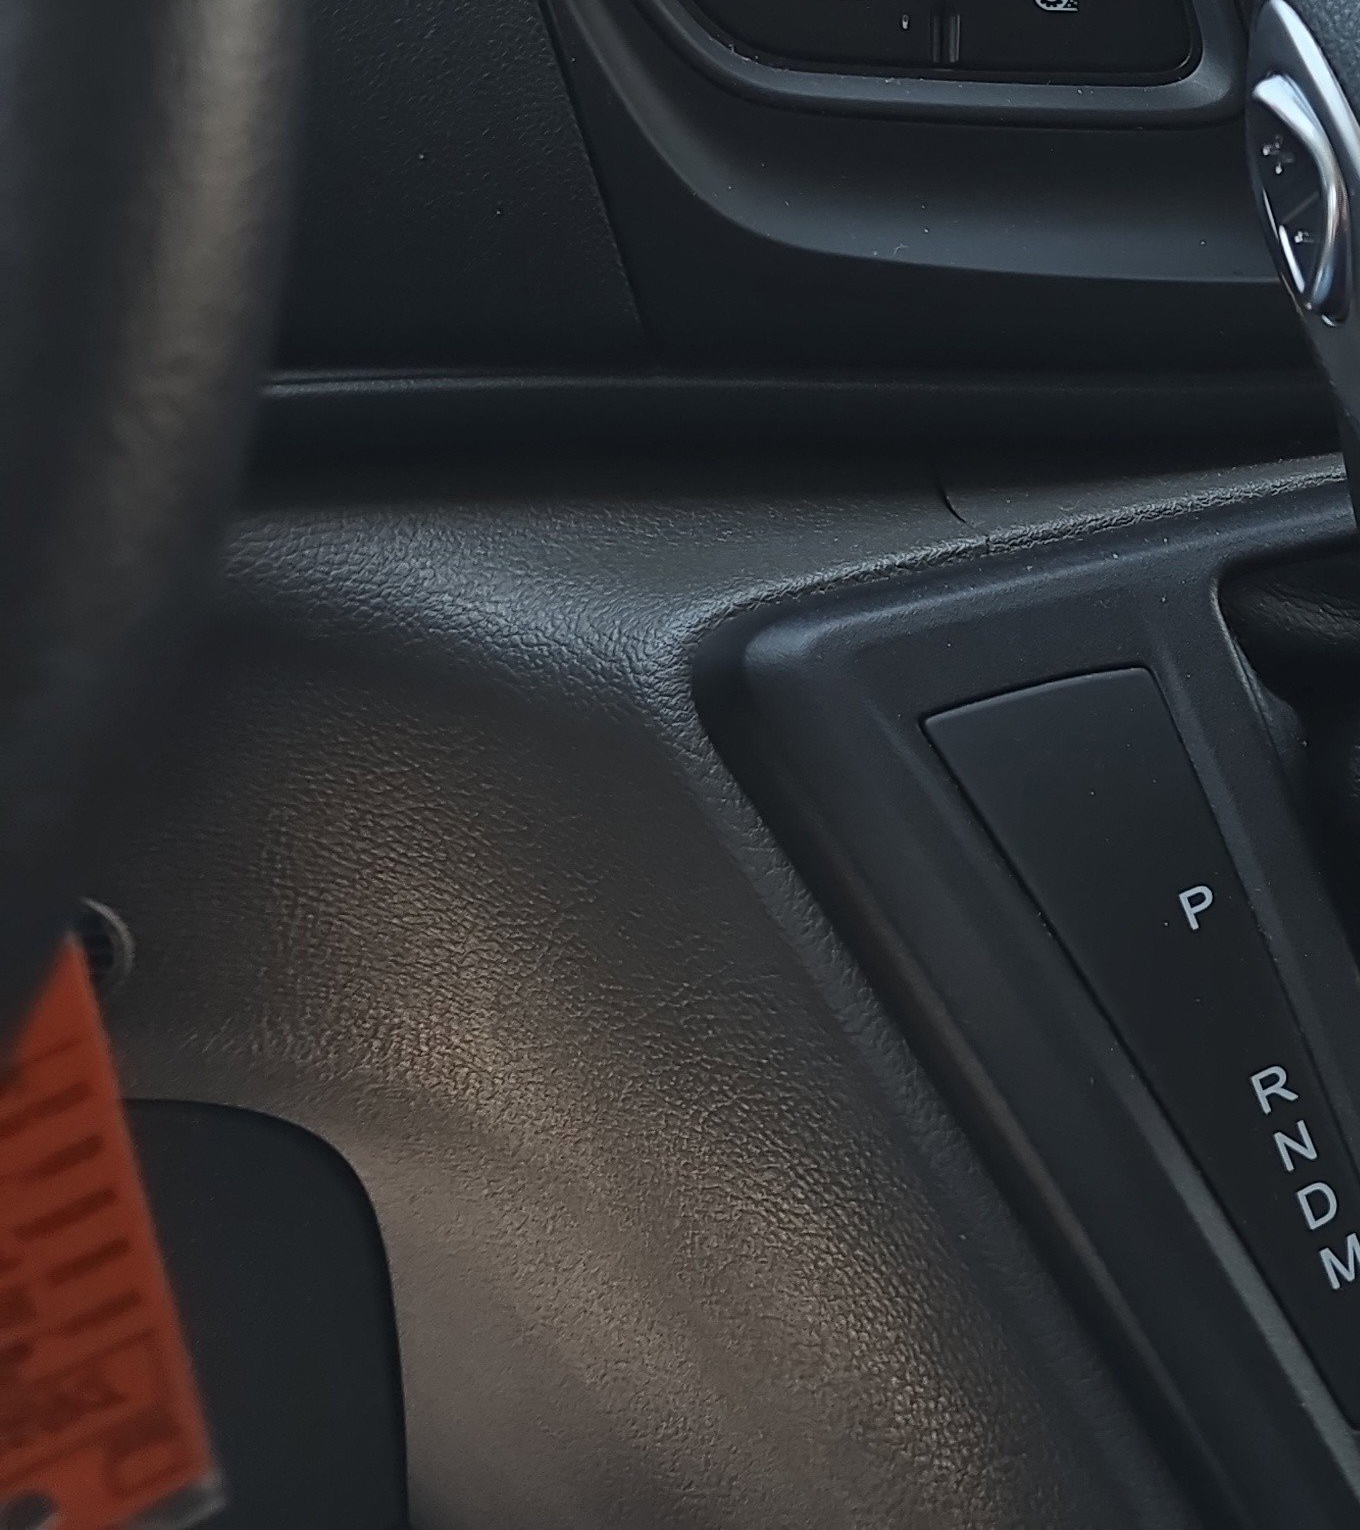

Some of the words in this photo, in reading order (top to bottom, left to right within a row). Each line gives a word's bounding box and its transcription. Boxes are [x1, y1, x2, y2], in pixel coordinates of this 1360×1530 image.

[1178, 885, 1213, 930] P
[1250, 1065, 1298, 1113] R
[1273, 1120, 1317, 1171] N
[1297, 1182, 1337, 1230] D
